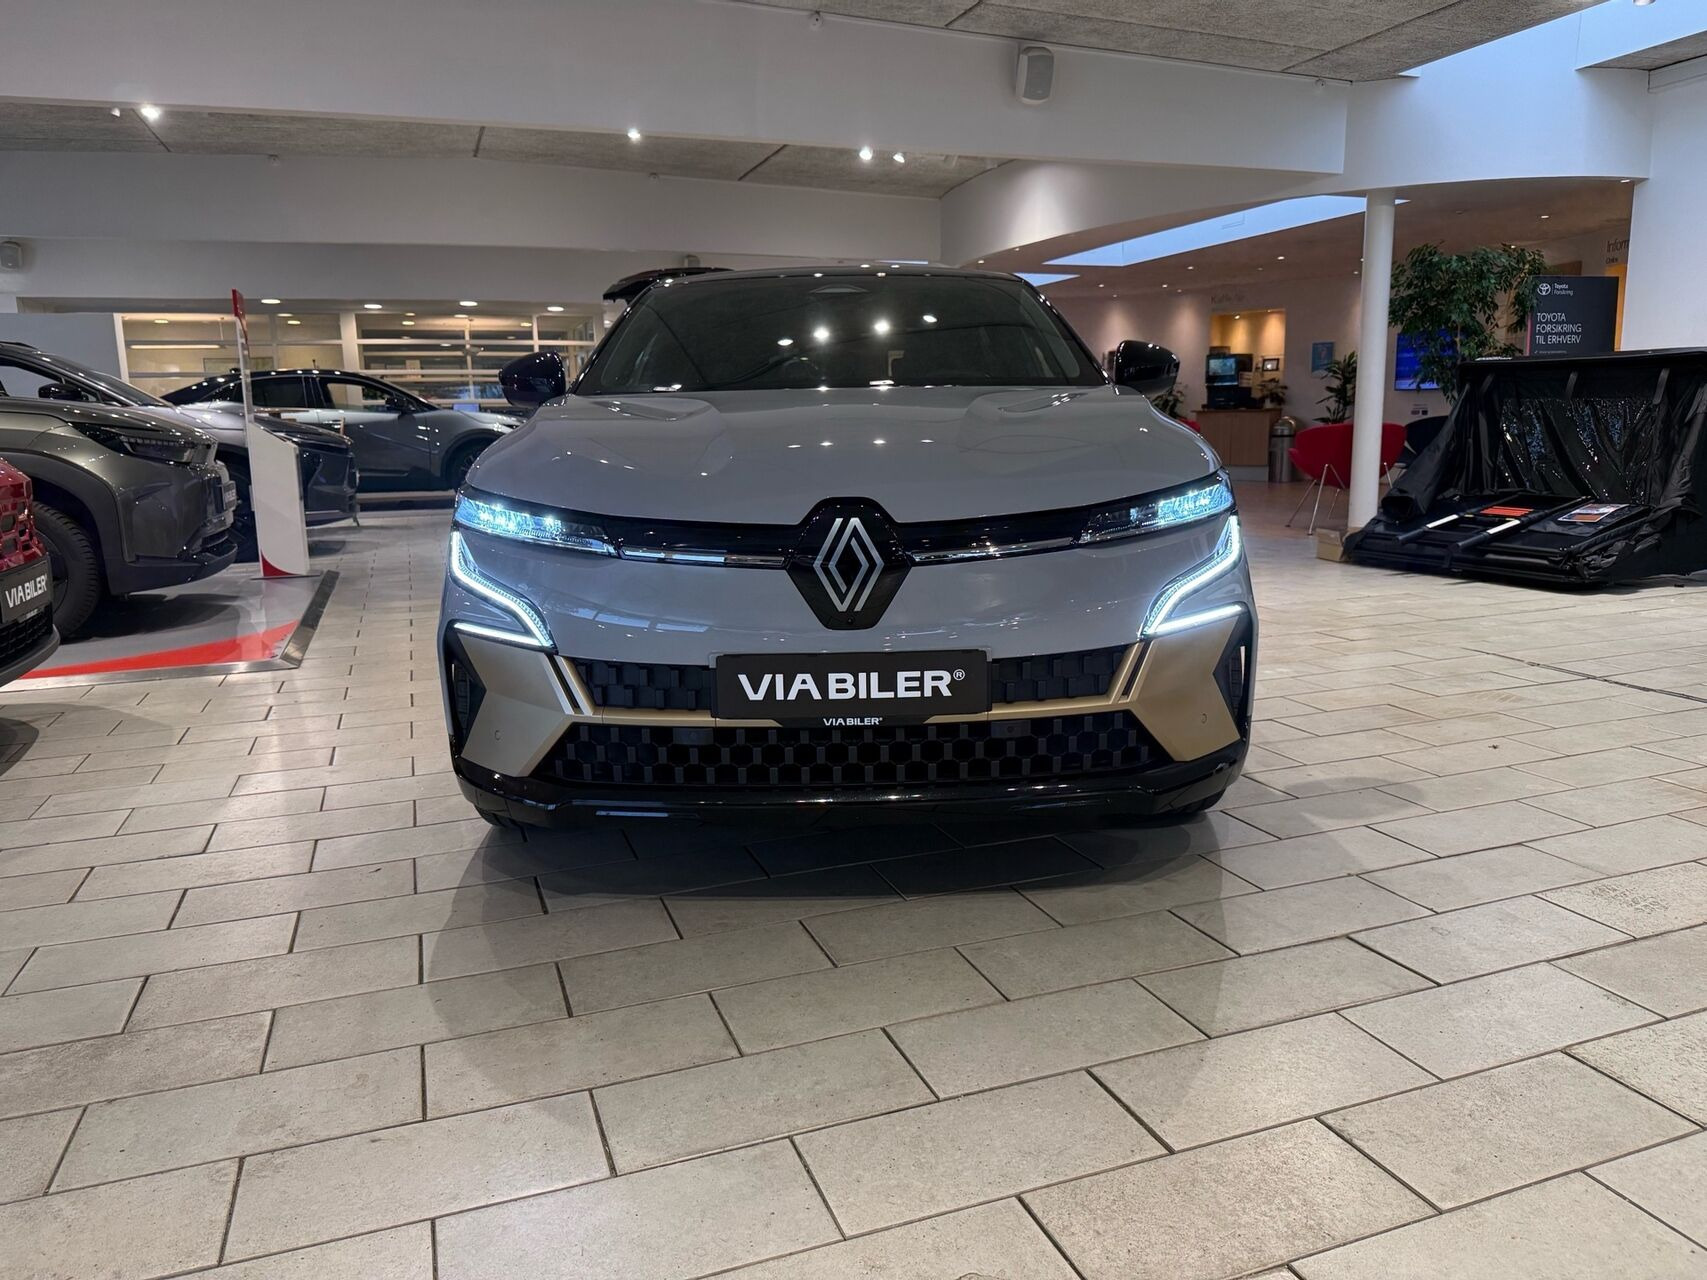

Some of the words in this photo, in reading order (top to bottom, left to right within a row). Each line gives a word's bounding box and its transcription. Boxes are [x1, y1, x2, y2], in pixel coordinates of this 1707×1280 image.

[1537, 312, 1566, 322] TOYOTA
[1536, 323, 1582, 334] FORSIKRING
[1535, 335, 1546, 345] TIL
[1547, 334, 1582, 344] ERHVERV
[737, 672, 822, 701] VIA
